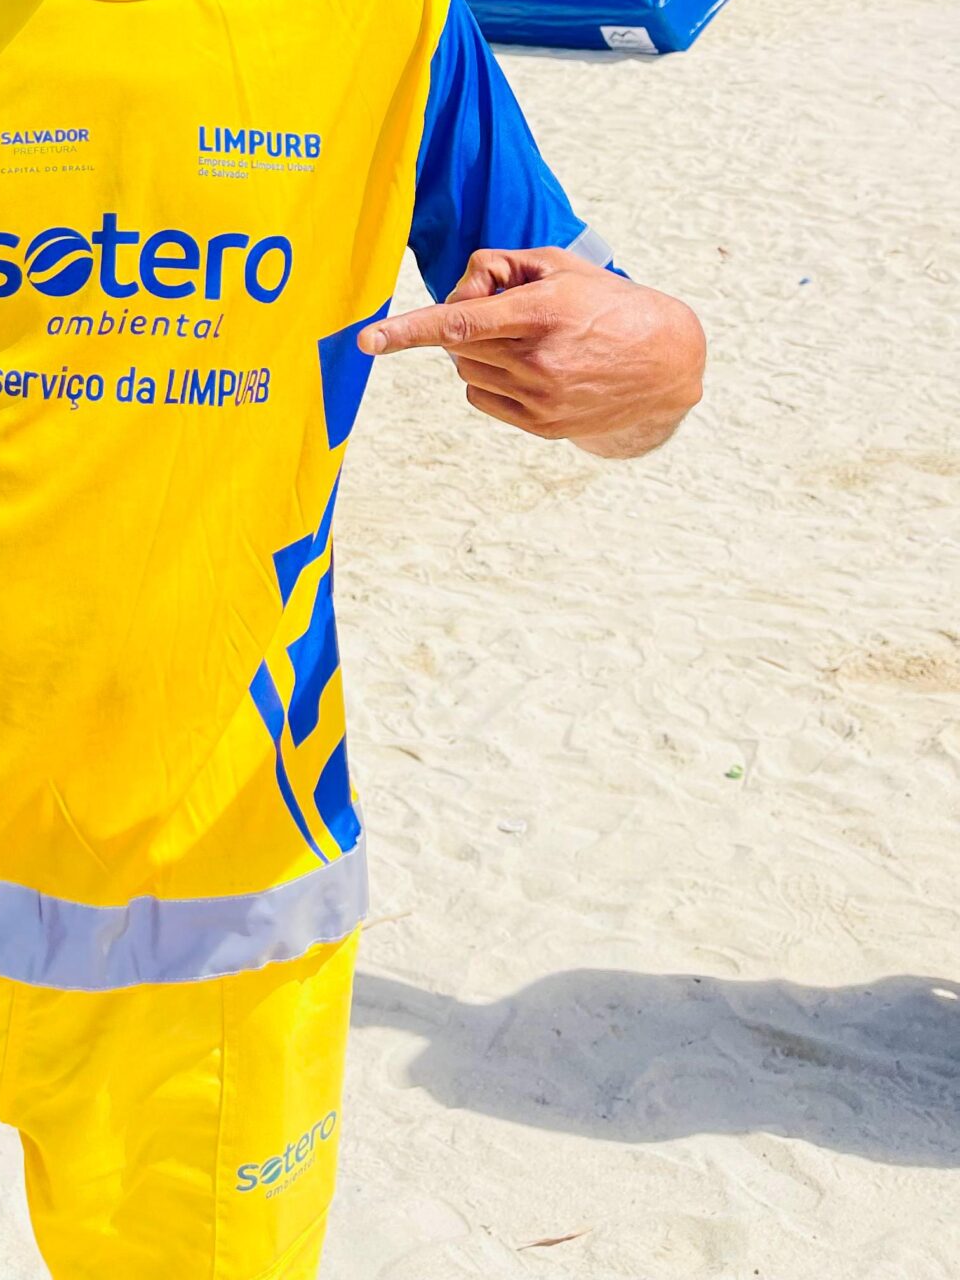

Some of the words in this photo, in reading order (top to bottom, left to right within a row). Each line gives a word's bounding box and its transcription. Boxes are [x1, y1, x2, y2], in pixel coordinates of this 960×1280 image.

[1, 129, 89, 145] SALVADOR
[198, 126, 321, 158] LIMPURB
[13, 145, 78, 156] PREFEITURA
[198, 156, 236, 168] Empresa
[0, 166, 41, 175] CAPITAL
[44, 165, 59, 173] DO
[61, 164, 96, 172] BRASIL
[46, 308, 225, 340] ambiental
[116, 366, 156, 405] da
[164, 367, 271, 407] LIMPURB
[235, 1110, 337, 1192] sotero
